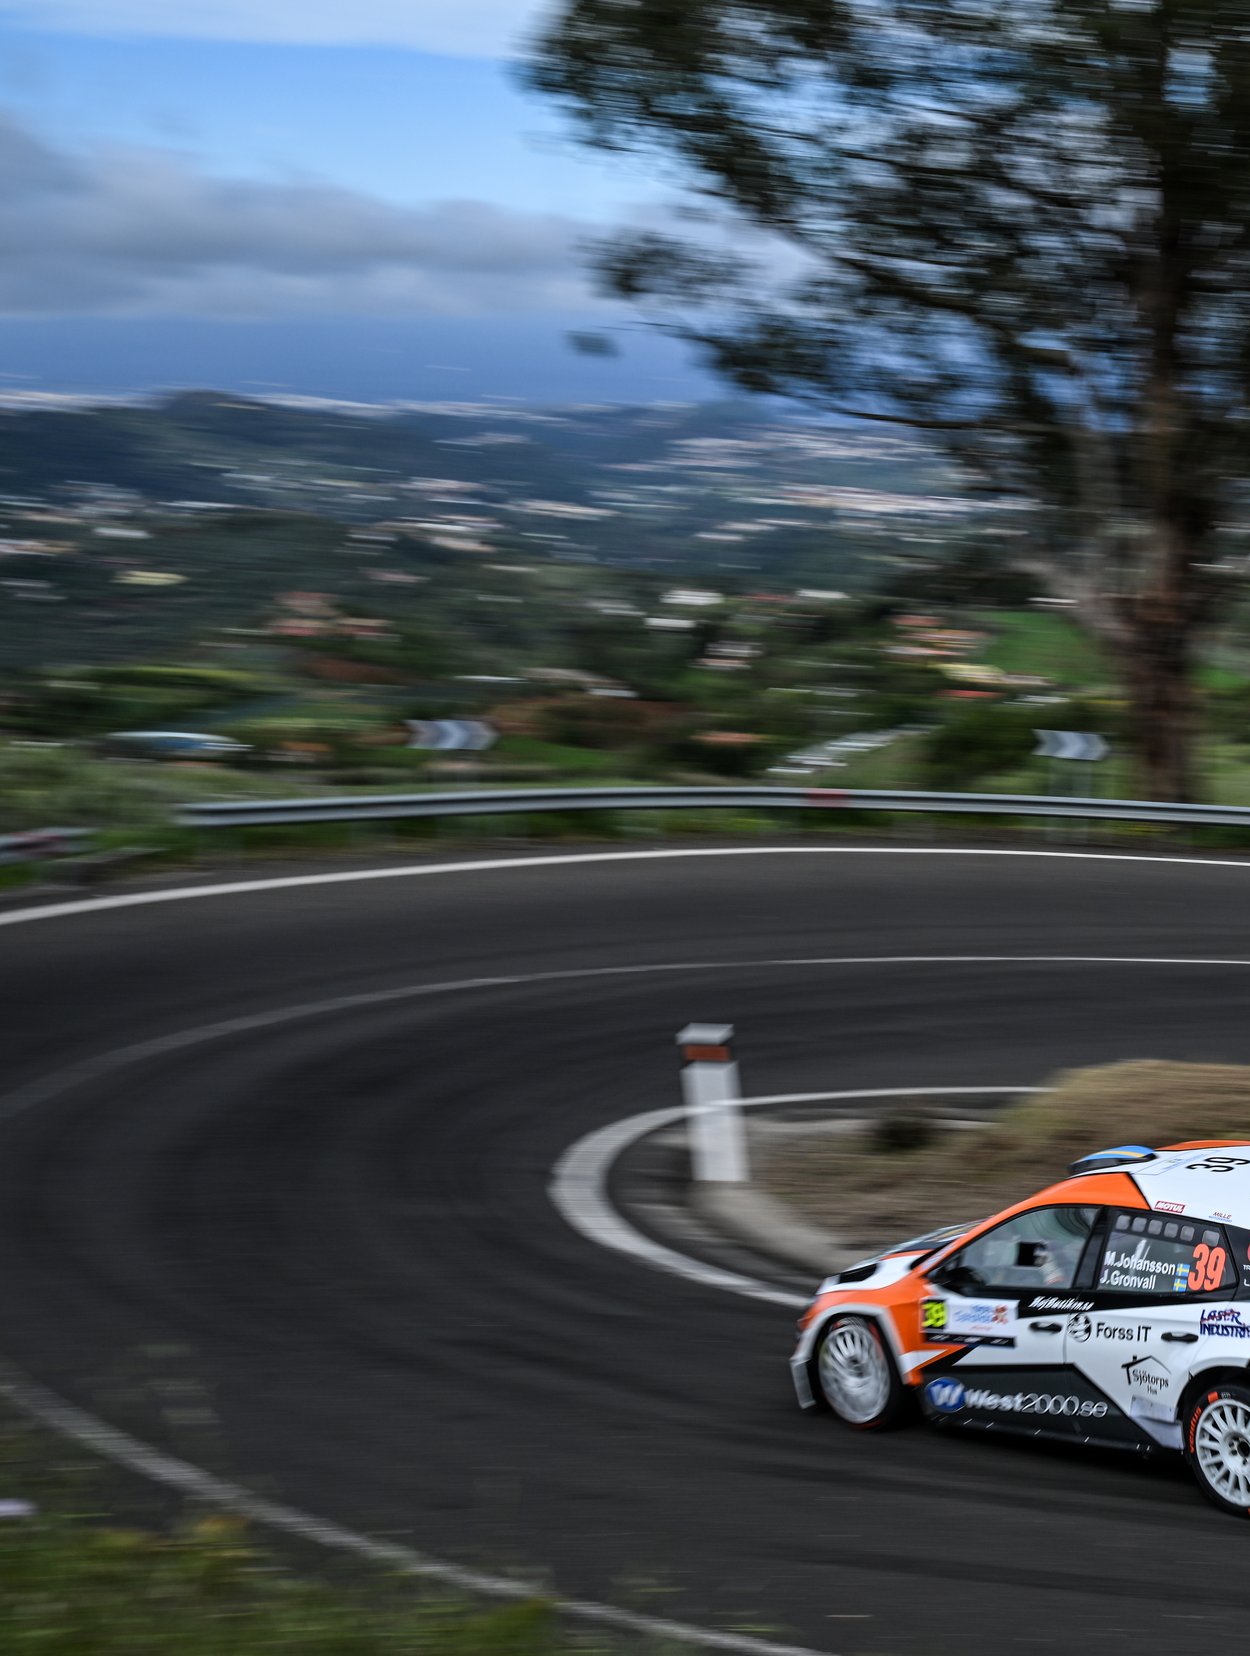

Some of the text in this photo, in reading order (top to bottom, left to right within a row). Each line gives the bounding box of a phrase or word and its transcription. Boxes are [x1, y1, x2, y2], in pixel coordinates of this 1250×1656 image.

[1155, 1201, 1183, 1213] MOTUL
[1103, 1250, 1176, 1276] M.Johansson
[1187, 1243, 1226, 1292] 39
[1099, 1268, 1157, 1290] J.Gronvall
[921, 1301, 949, 1328] 39
[1200, 1308, 1243, 1325] LASER
[1096, 1321, 1152, 1342] Forss IT
[1132, 1369, 1169, 1391] Sjötorps
[964, 1388, 1109, 1418] West2000.se
